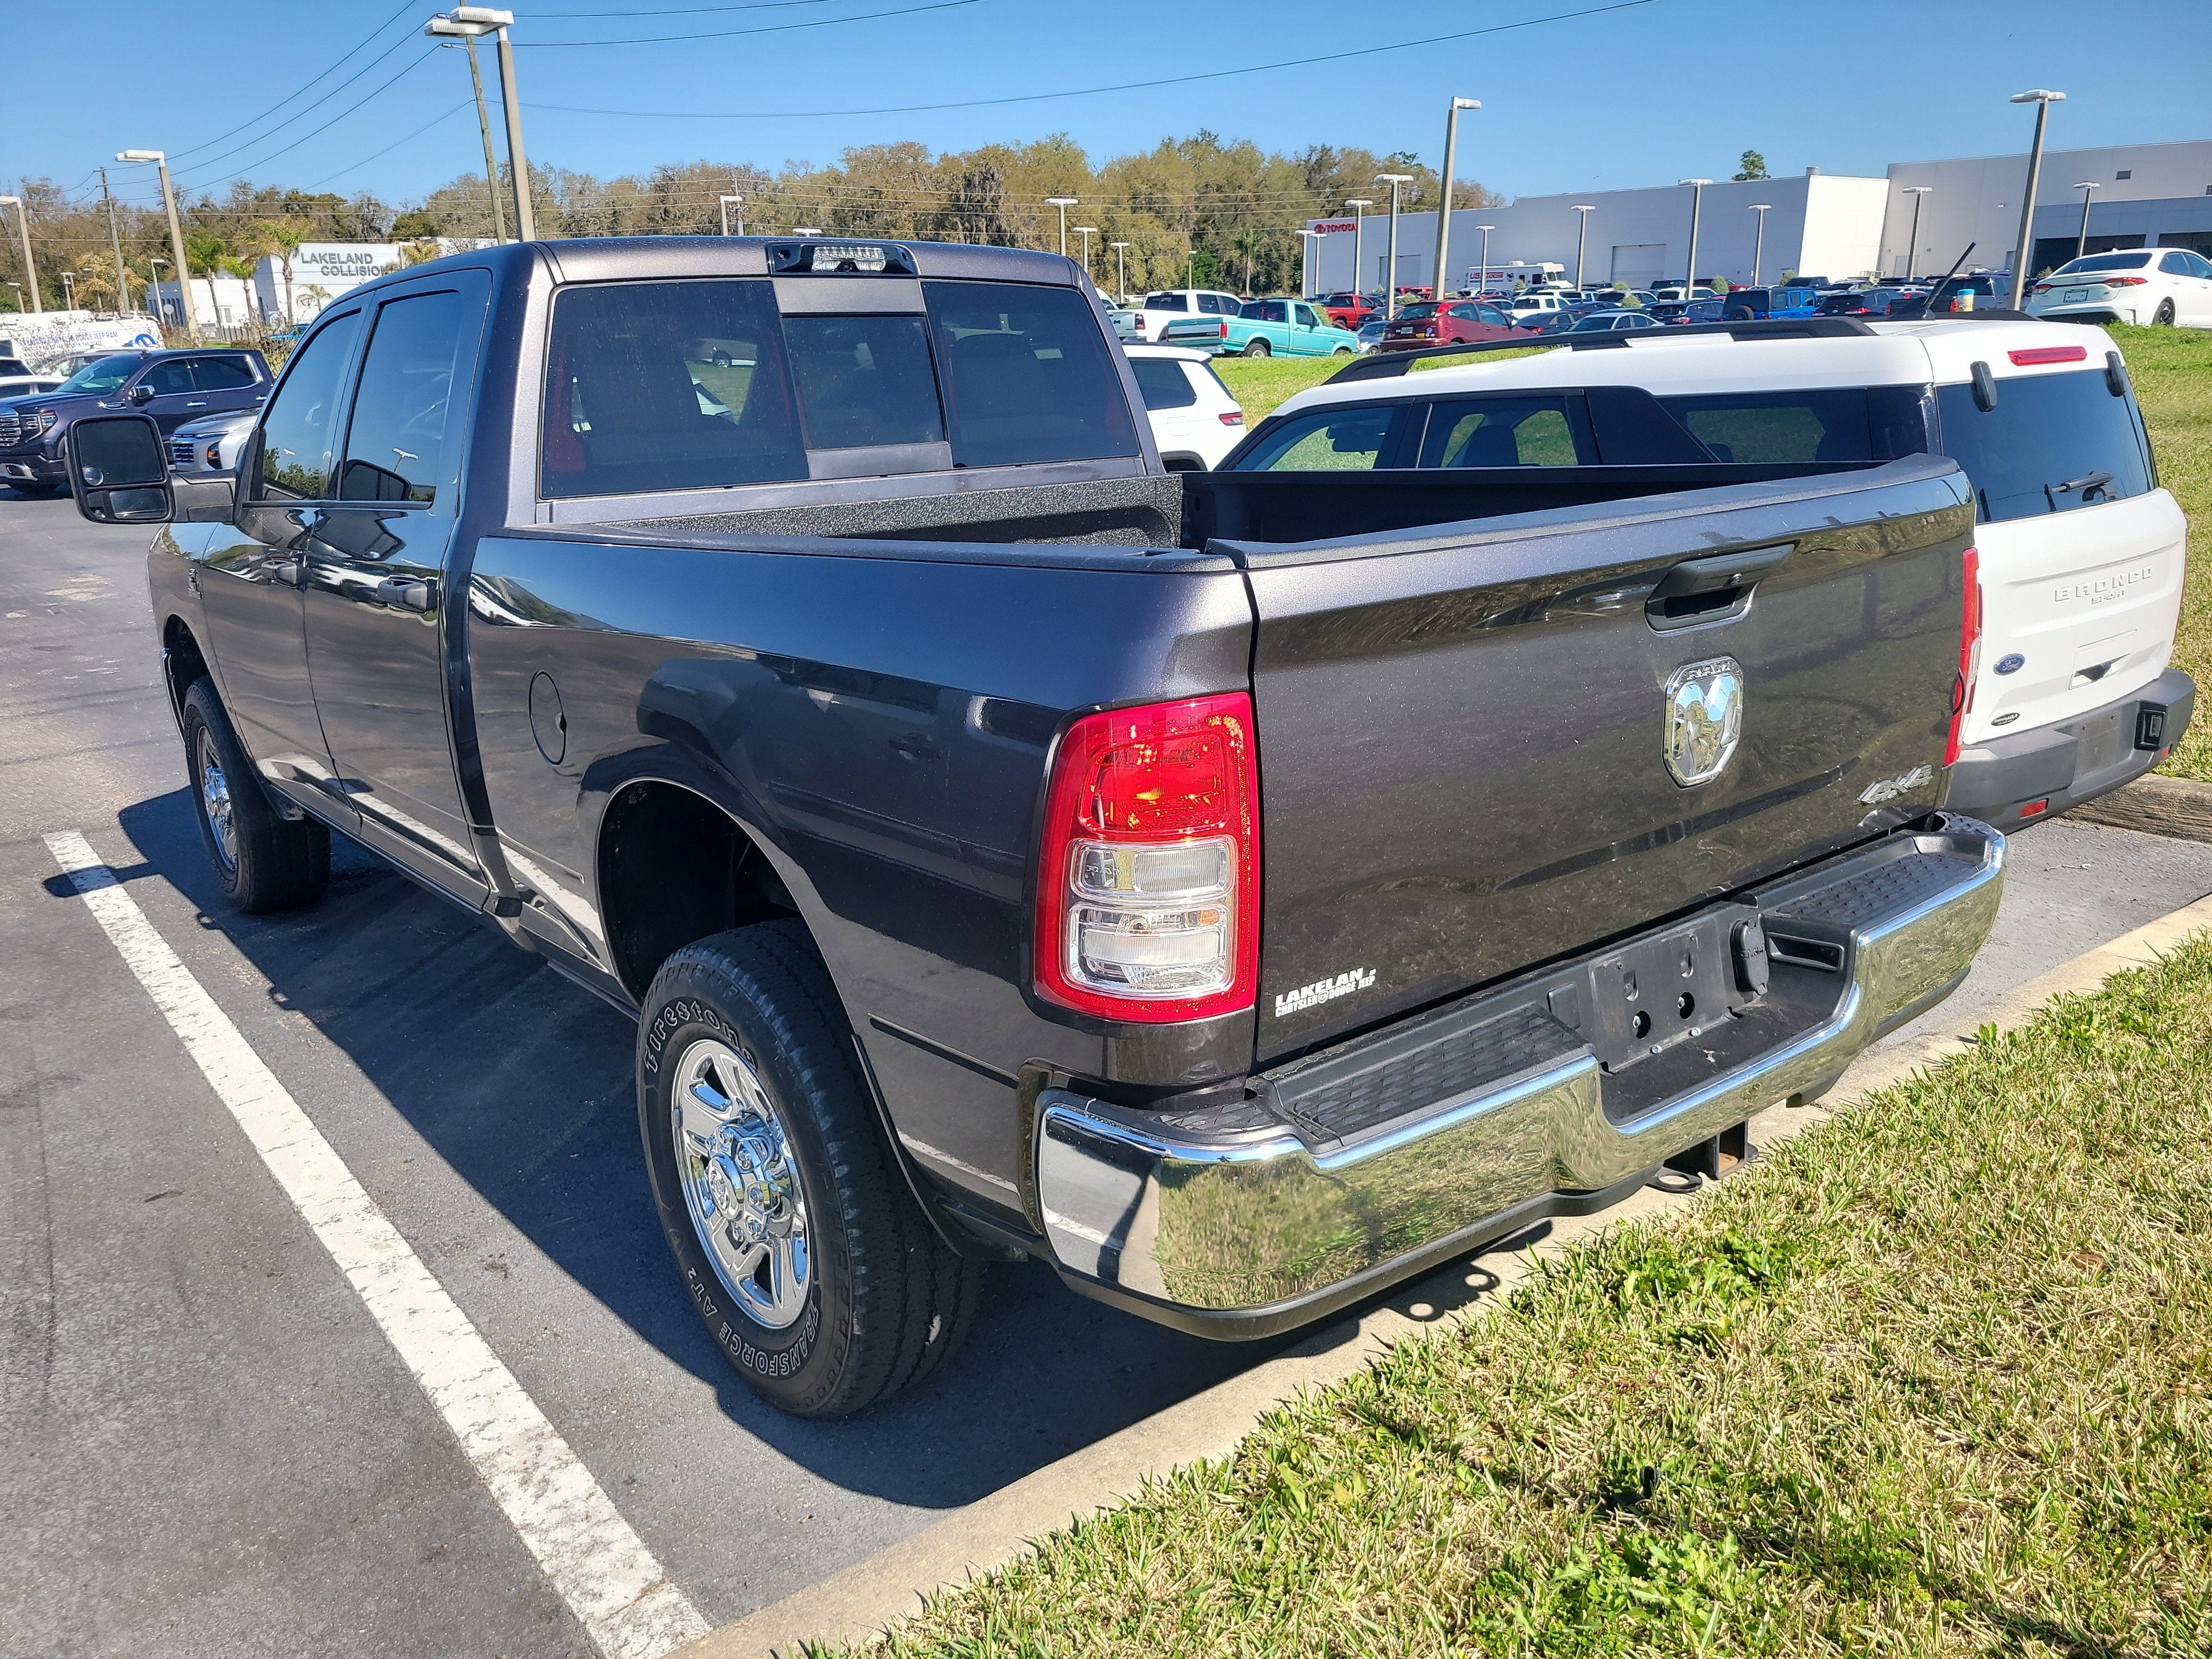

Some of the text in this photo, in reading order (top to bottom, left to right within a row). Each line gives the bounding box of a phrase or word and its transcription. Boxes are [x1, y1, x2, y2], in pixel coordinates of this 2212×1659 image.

[1326, 223, 1357, 233] TOYOTA
[301, 252, 373, 264] LAKELAND
[2055, 567, 2153, 602] BRONCO
[2091, 589, 2126, 604] SPORT
[1275, 975, 1375, 1018] CHRYSLER DODGE JEEP
[644, 1001, 759, 1074] Firestone
[719, 1300, 819, 1376] TRANSFORCE
